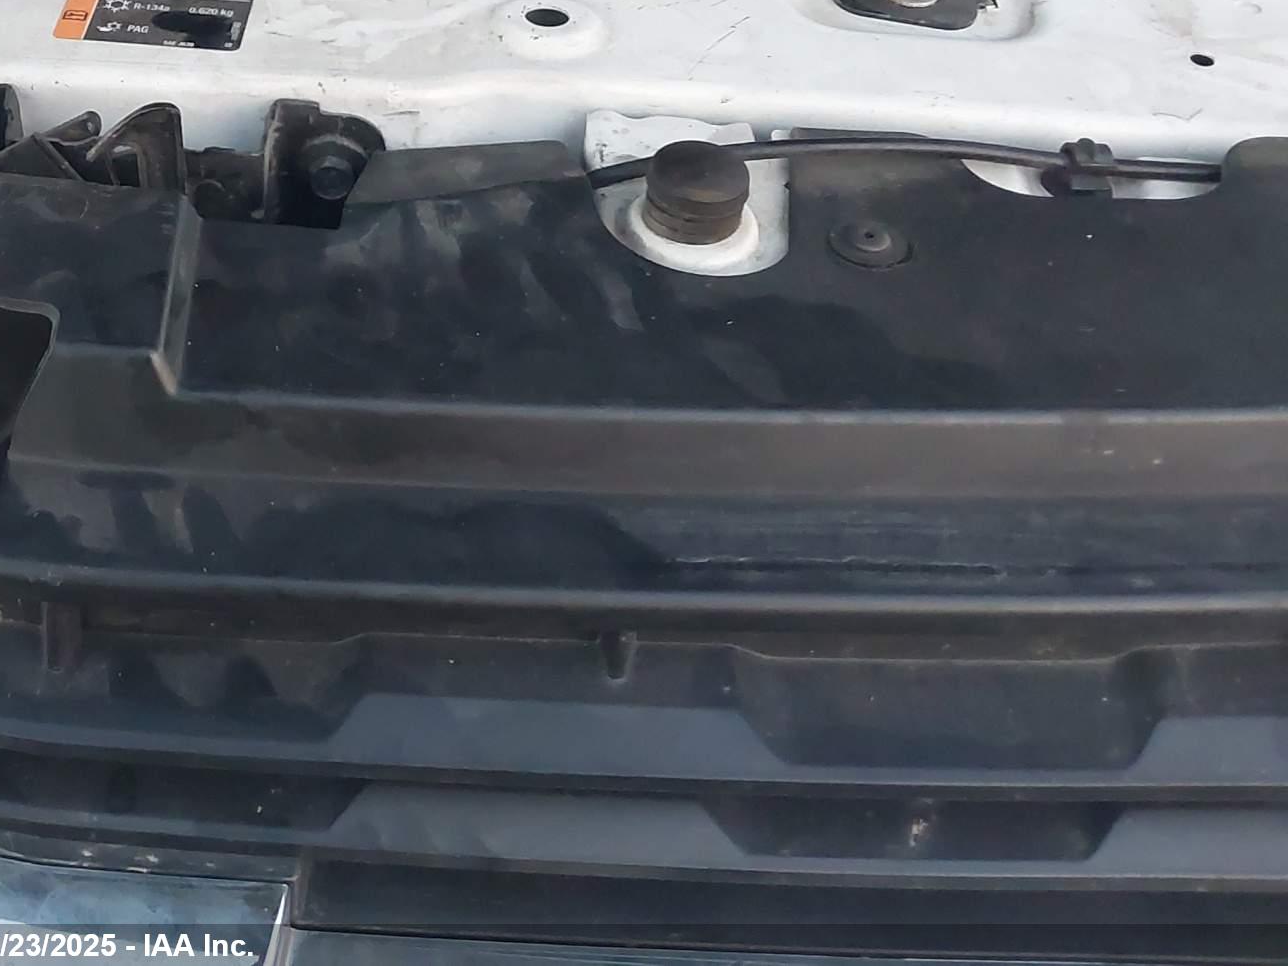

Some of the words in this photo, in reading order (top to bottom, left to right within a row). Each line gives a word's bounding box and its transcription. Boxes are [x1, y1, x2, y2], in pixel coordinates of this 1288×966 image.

[133, 3, 171, 12] R-134a
[220, 8, 234, 18] kg
[127, 24, 149, 34] PAG
